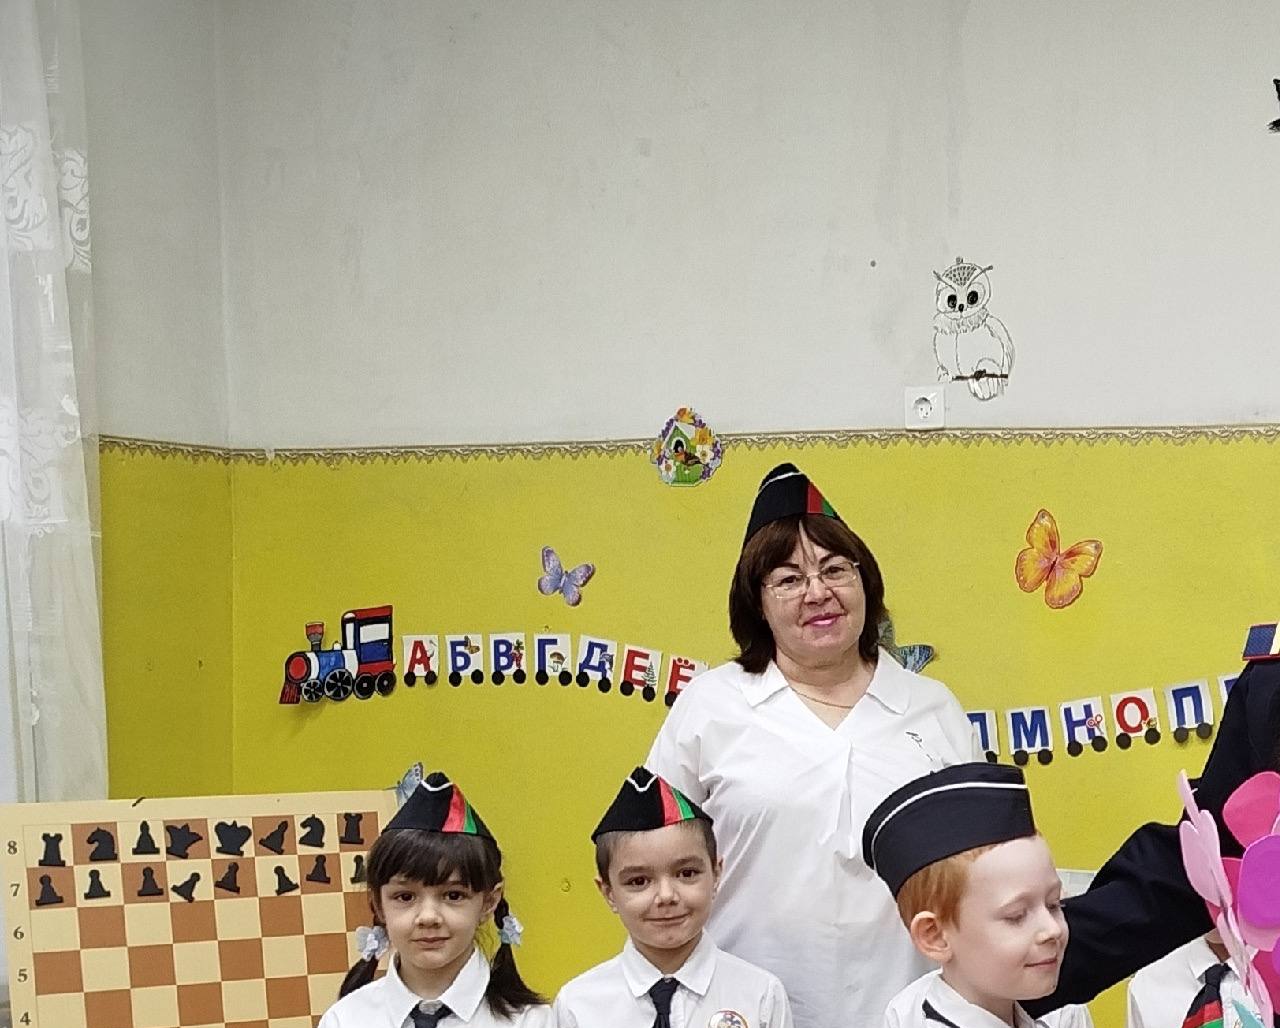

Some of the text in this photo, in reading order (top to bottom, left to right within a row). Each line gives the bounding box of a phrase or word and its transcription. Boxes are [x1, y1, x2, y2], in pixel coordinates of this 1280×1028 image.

[7, 840, 18, 855] 8
[10, 883, 20, 897] 7
[13, 925, 25, 940] 6
[17, 968, 28, 983] 5
[19, 1011, 32, 1026] 4
